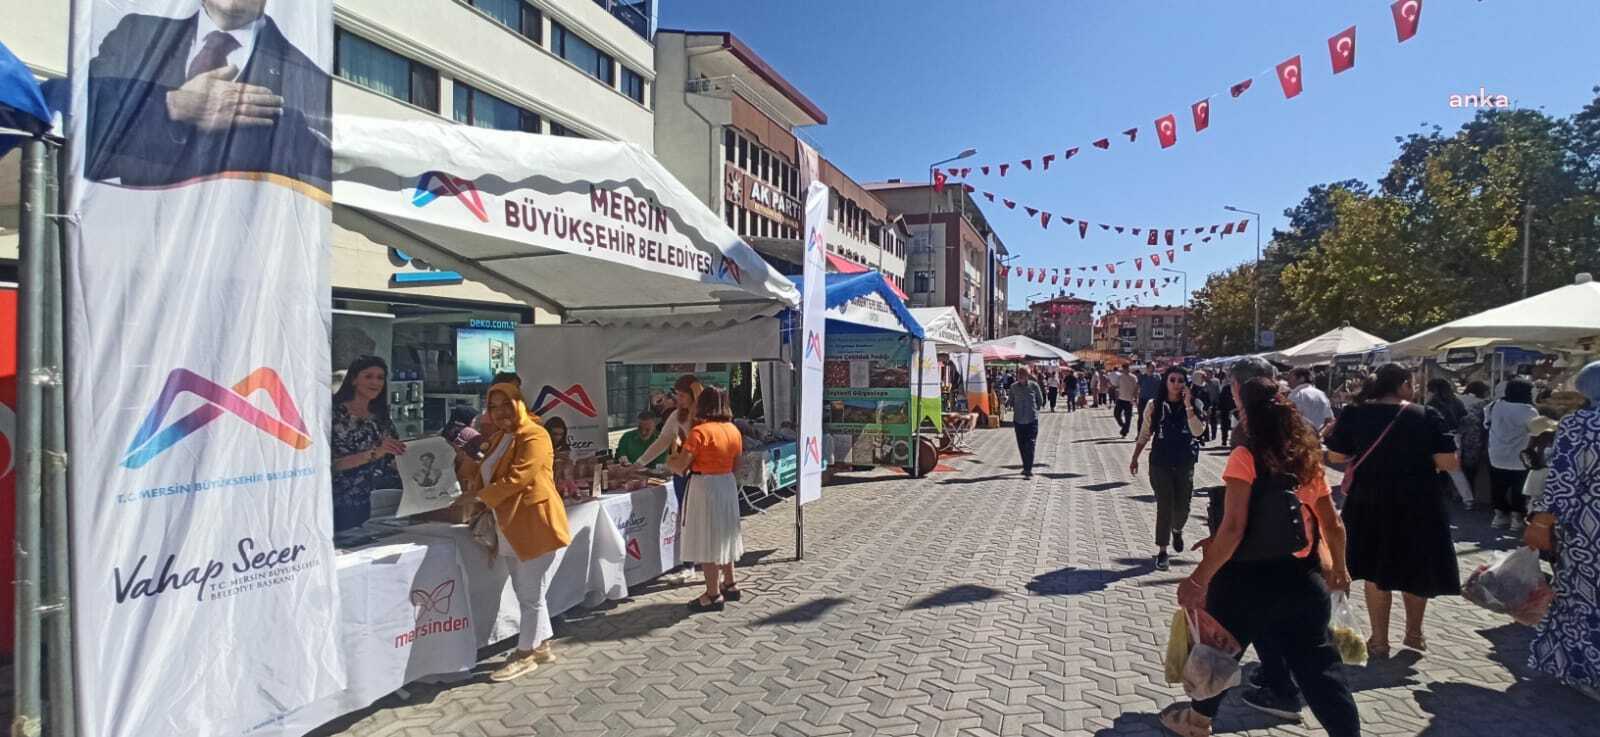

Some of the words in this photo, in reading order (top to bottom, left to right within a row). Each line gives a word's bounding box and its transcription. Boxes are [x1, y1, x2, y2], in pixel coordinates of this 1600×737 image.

[589, 183, 668, 235] MERSİN
[751, 181, 770, 208] AK
[504, 197, 636, 257] BÜYÜKŞEHİR
[141, 481, 192, 498] MERSİN
[114, 553, 224, 604] Vahap
[232, 537, 307, 573] Seçer
[394, 616, 470, 649] mersinden
